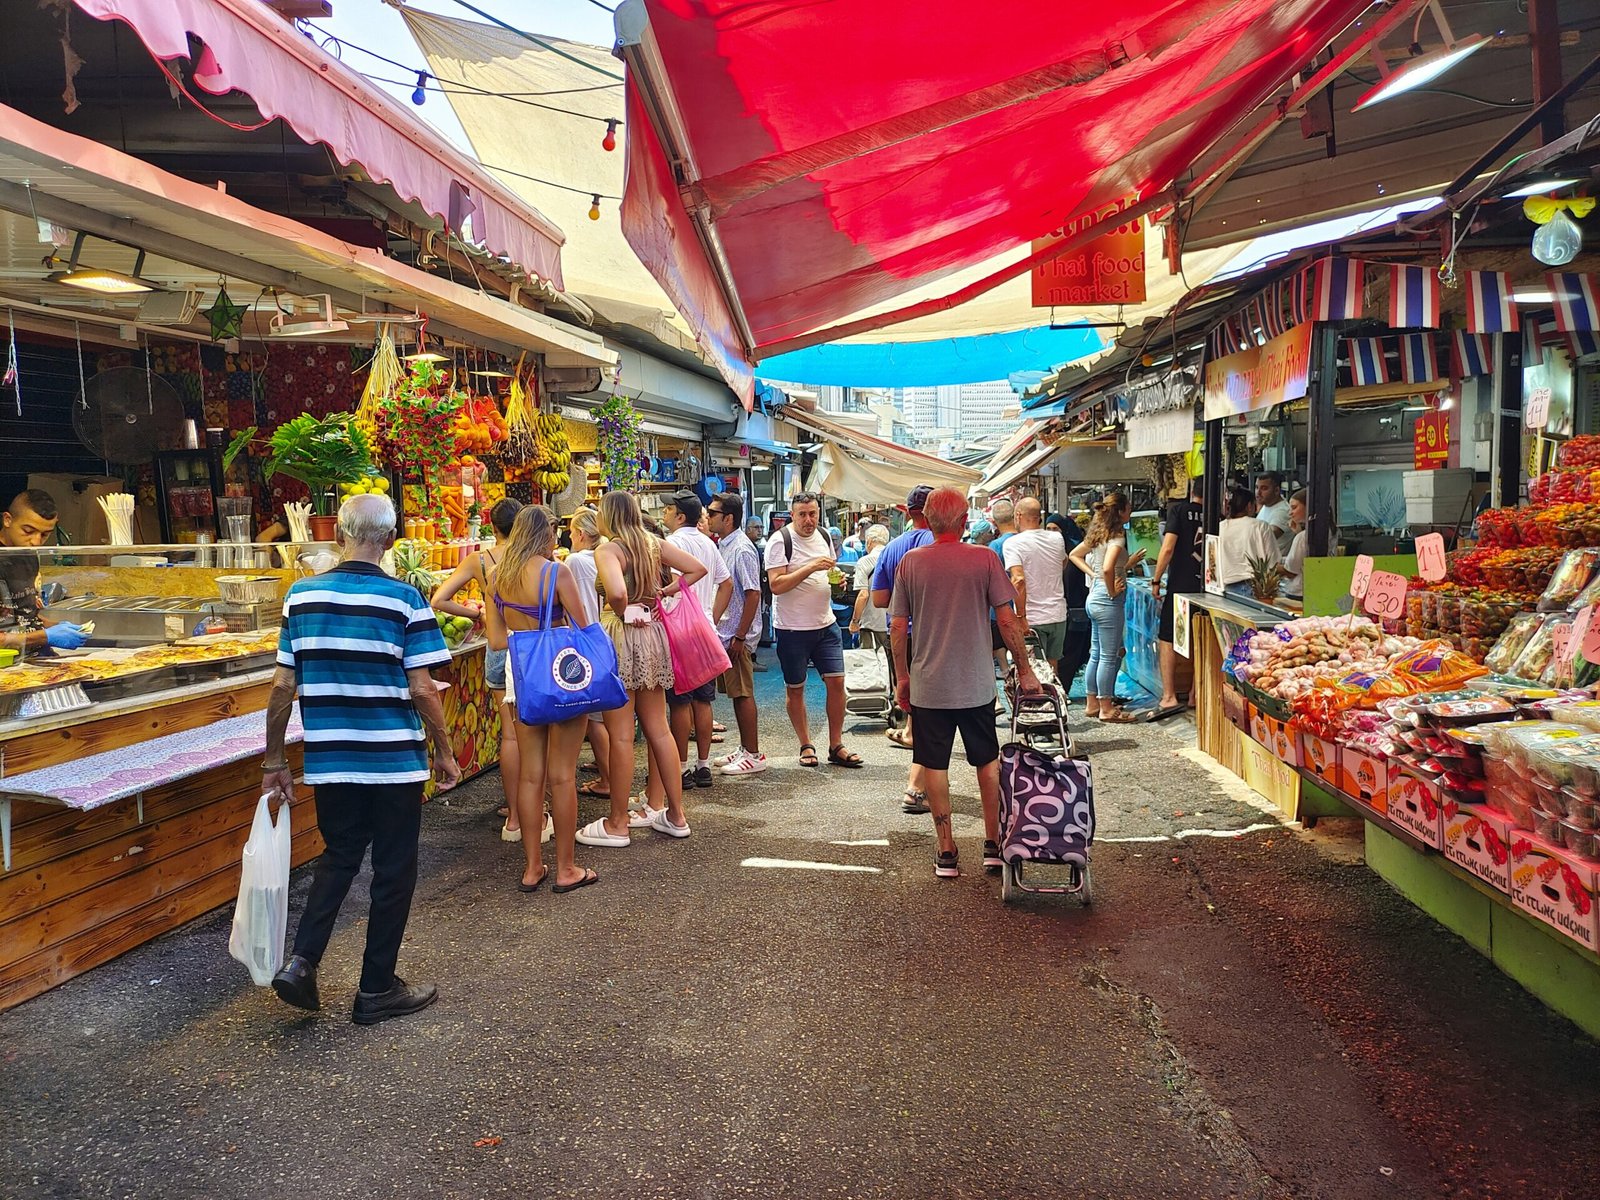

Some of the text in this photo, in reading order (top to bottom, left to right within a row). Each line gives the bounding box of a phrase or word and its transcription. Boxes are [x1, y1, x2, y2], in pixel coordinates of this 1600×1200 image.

[1093, 251, 1145, 280] food
[1049, 280, 1130, 303] market
[1527, 404, 1543, 426] 14
[1418, 545, 1444, 572] 14
[1354, 571, 1369, 594] 35
[1372, 592, 1400, 614] 30
[1512, 887, 1591, 943] גבי גבריאל חקלאות
